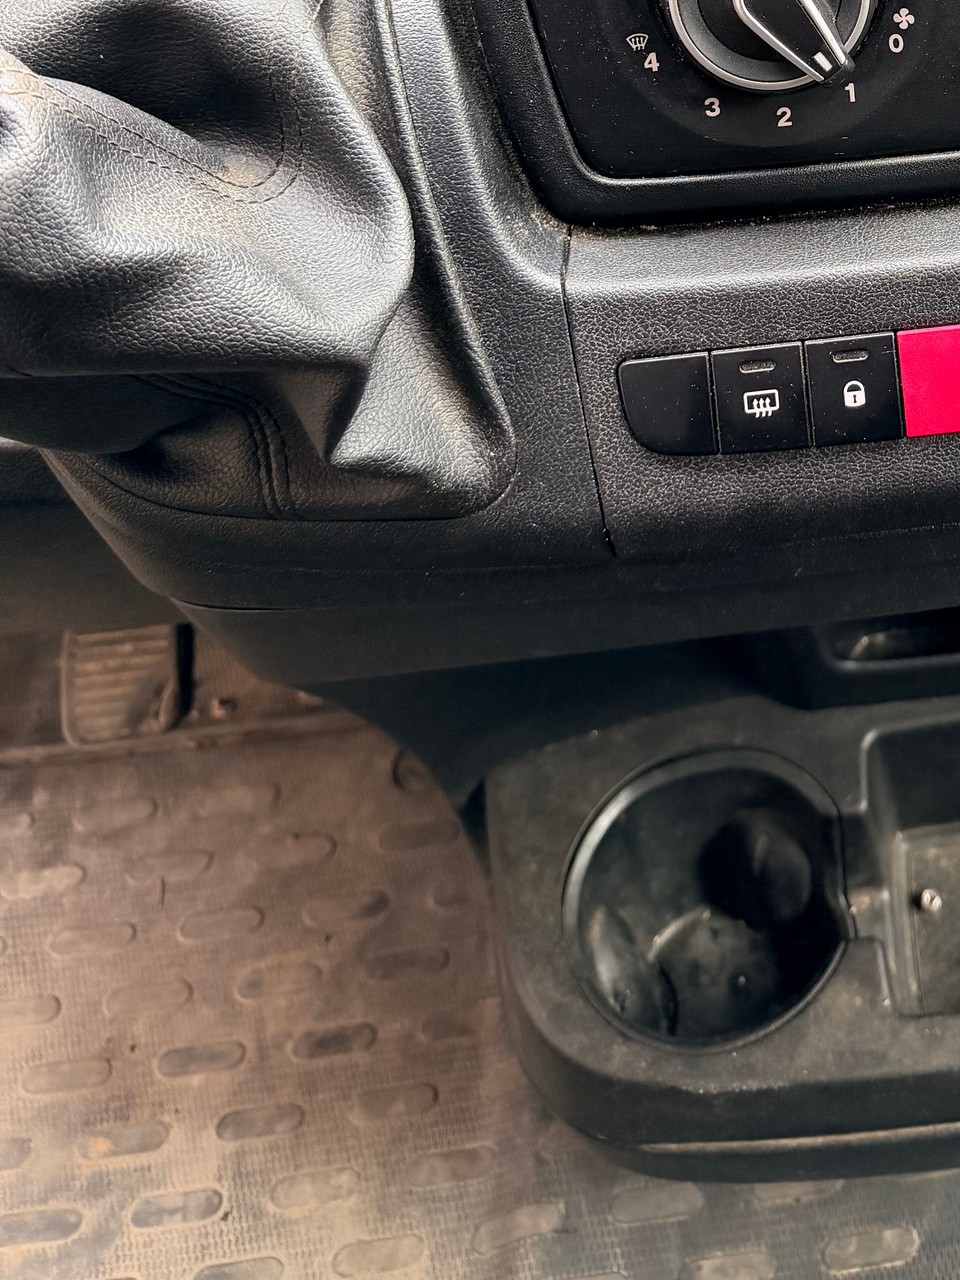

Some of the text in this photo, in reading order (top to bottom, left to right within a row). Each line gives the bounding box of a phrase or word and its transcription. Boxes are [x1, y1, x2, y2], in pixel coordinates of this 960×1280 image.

[888, 33, 904, 53] 0
[644, 52, 660, 72] 4
[844, 82, 857, 102] 1
[704, 97, 721, 117] 3
[776, 107, 793, 127] 2
